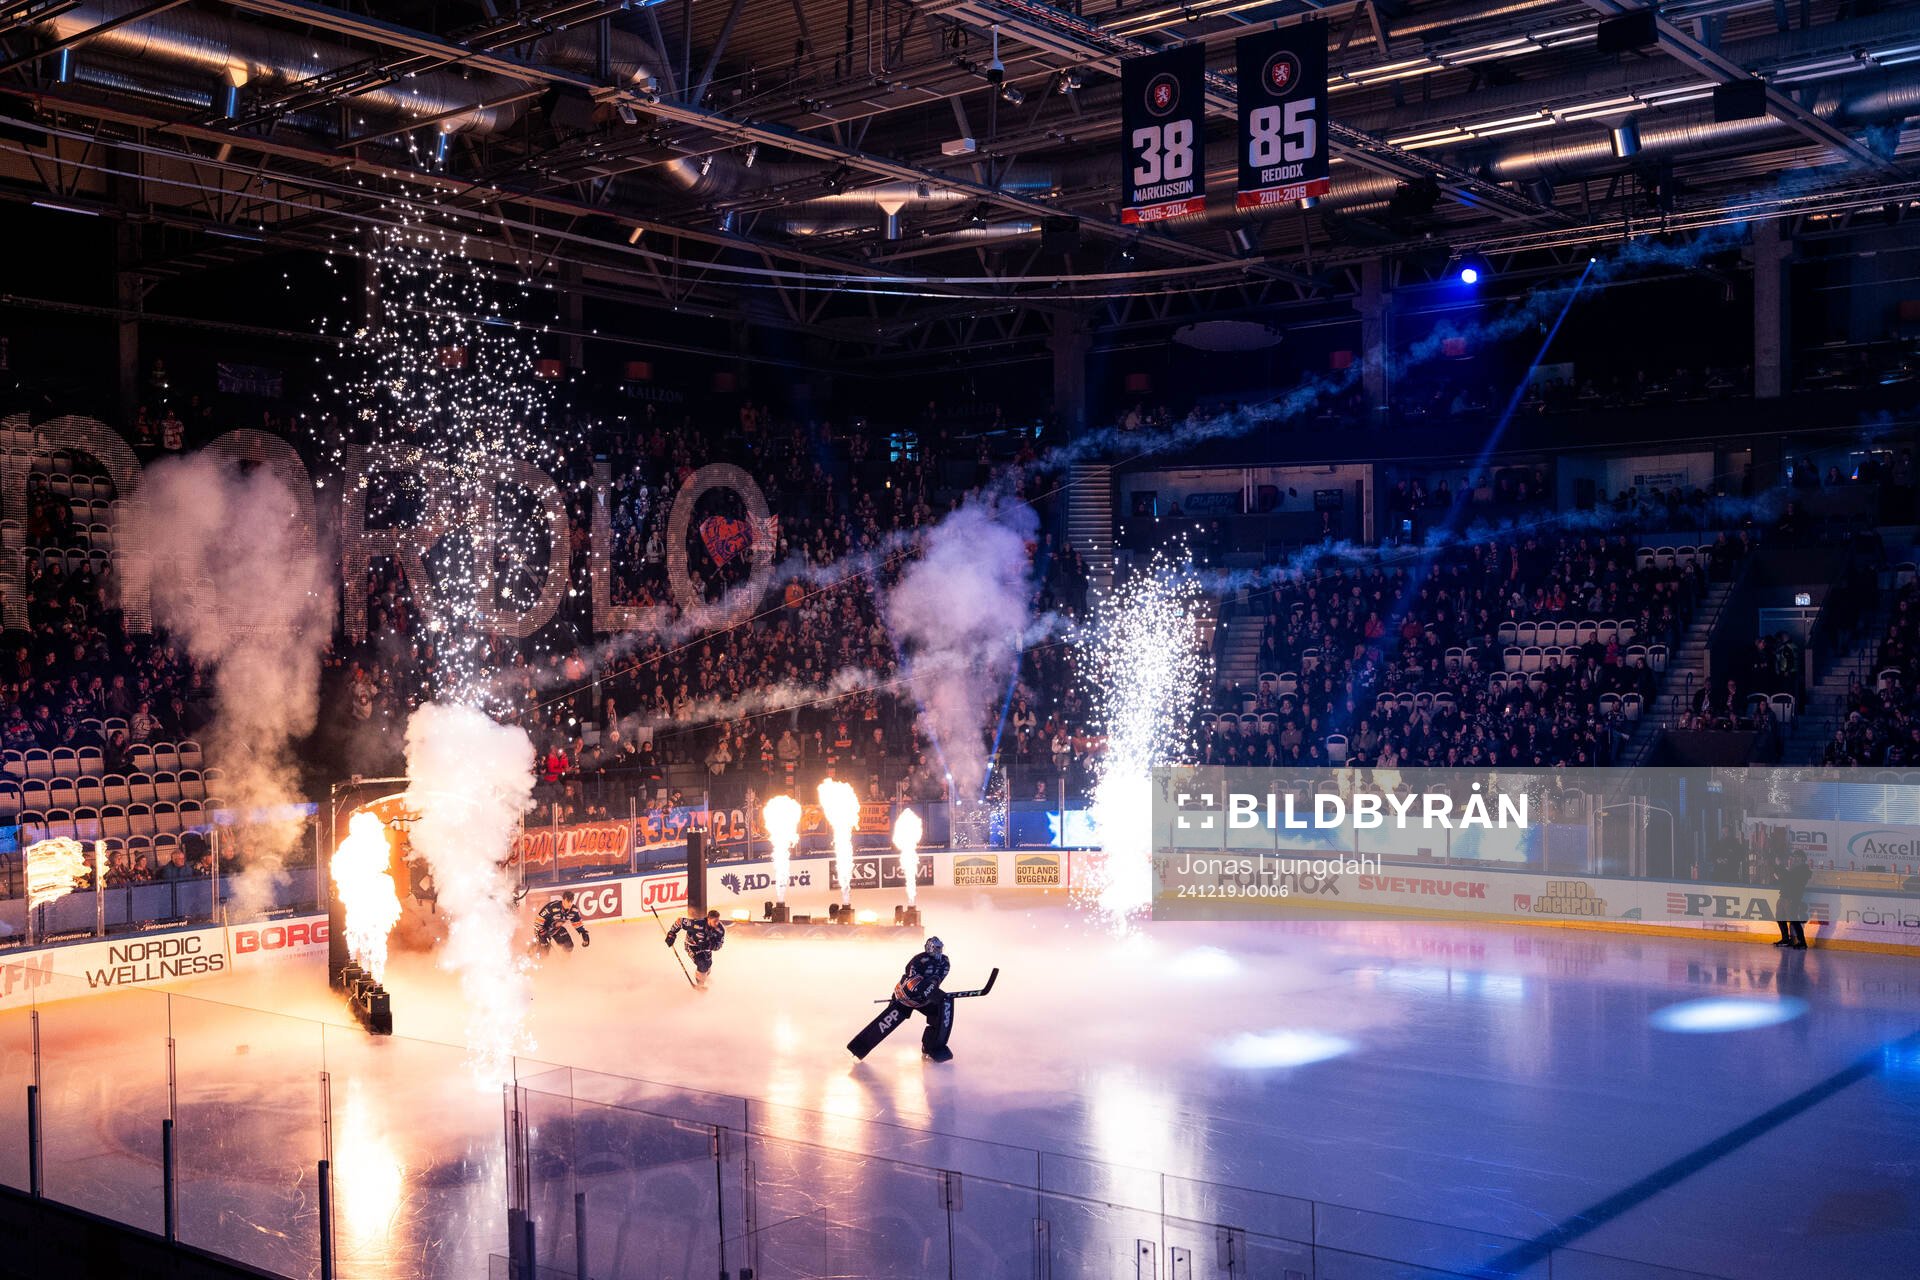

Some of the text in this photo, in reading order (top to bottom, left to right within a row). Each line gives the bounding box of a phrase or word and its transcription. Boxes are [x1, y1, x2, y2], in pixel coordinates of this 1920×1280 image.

[1250, 98, 1316, 168] 85
[1132, 119, 1193, 186] 38
[1262, 163, 1304, 183] REDDOX
[1133, 180, 1194, 203] MARKUSSON
[1260, 186, 1307, 204] 2011-2019
[1138, 202, 1188, 222] 2005-2014
[955, 866, 997, 877] GOTLANDS
[1017, 866, 1058, 876] GOTLANDS
[1358, 875, 1487, 898] SVETRUCK
[1546, 881, 1588, 897] EURO
[1684, 893, 1779, 921] PEA
[109, 936, 201, 964] NORDIC
[85, 953, 224, 989] WELLNESS
[878, 1009, 899, 1034] APP
